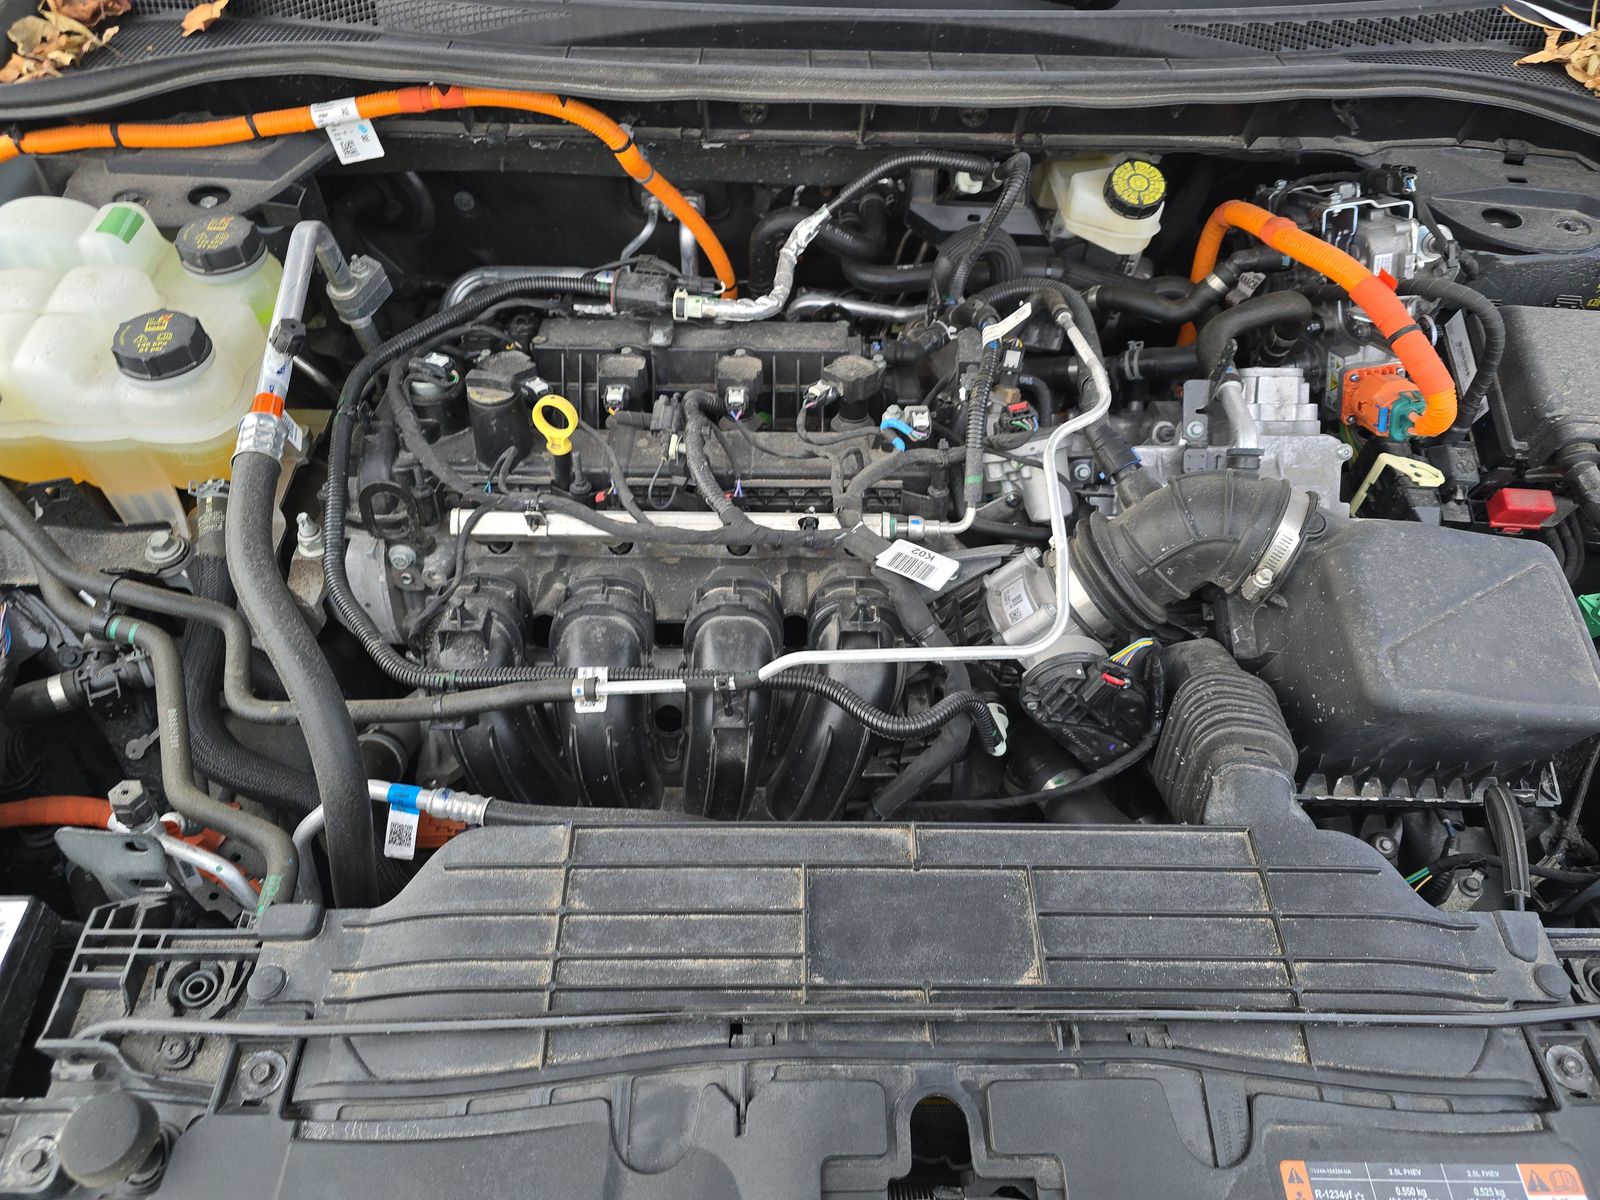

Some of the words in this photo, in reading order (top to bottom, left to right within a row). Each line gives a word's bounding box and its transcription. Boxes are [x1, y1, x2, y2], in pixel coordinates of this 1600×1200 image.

[911, 547, 936, 562] K02
[1388, 1167, 1403, 1176] 2.5L
[1404, 1168, 1422, 1177] PHEV
[1314, 1188, 1353, 1200] R-1234yf
[1395, 1186, 1415, 1196] 0.550
[1415, 1186, 1428, 1198] kg
[1473, 1186, 1494, 1197] 0.525
[1494, 1187, 1506, 1199] kg
